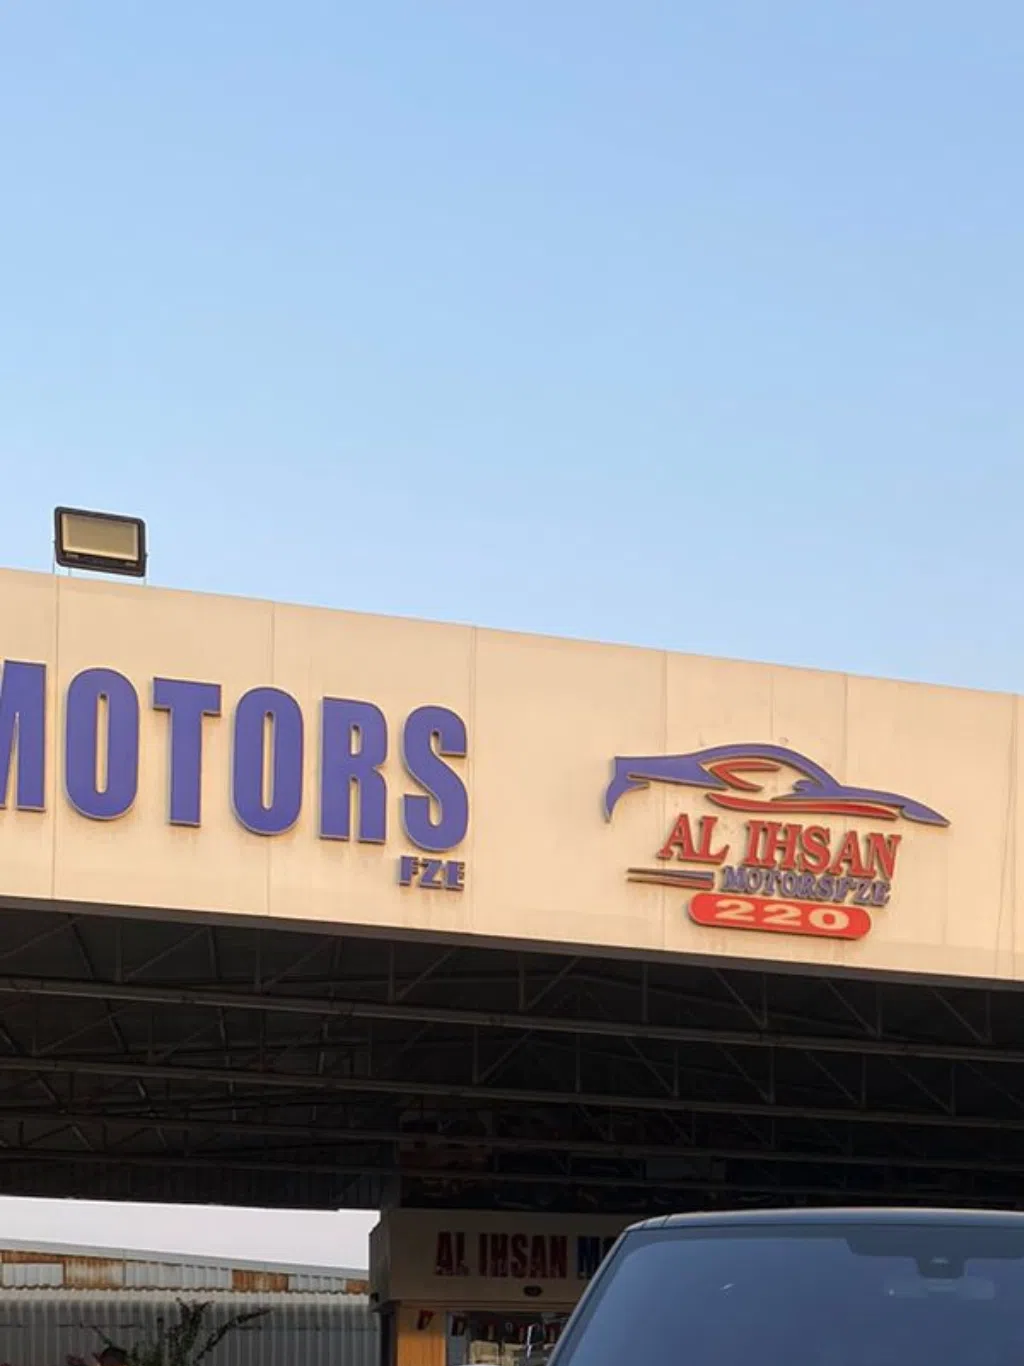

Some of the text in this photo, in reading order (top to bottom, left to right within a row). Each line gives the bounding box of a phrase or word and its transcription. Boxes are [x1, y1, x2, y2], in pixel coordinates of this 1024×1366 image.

[656, 813, 902, 879] AL IHSAN
[397, 855, 465, 891] FZE
[715, 899, 850, 931] 220
[434, 1231, 469, 1278] AL
[477, 1232, 568, 1280] IHSAN
